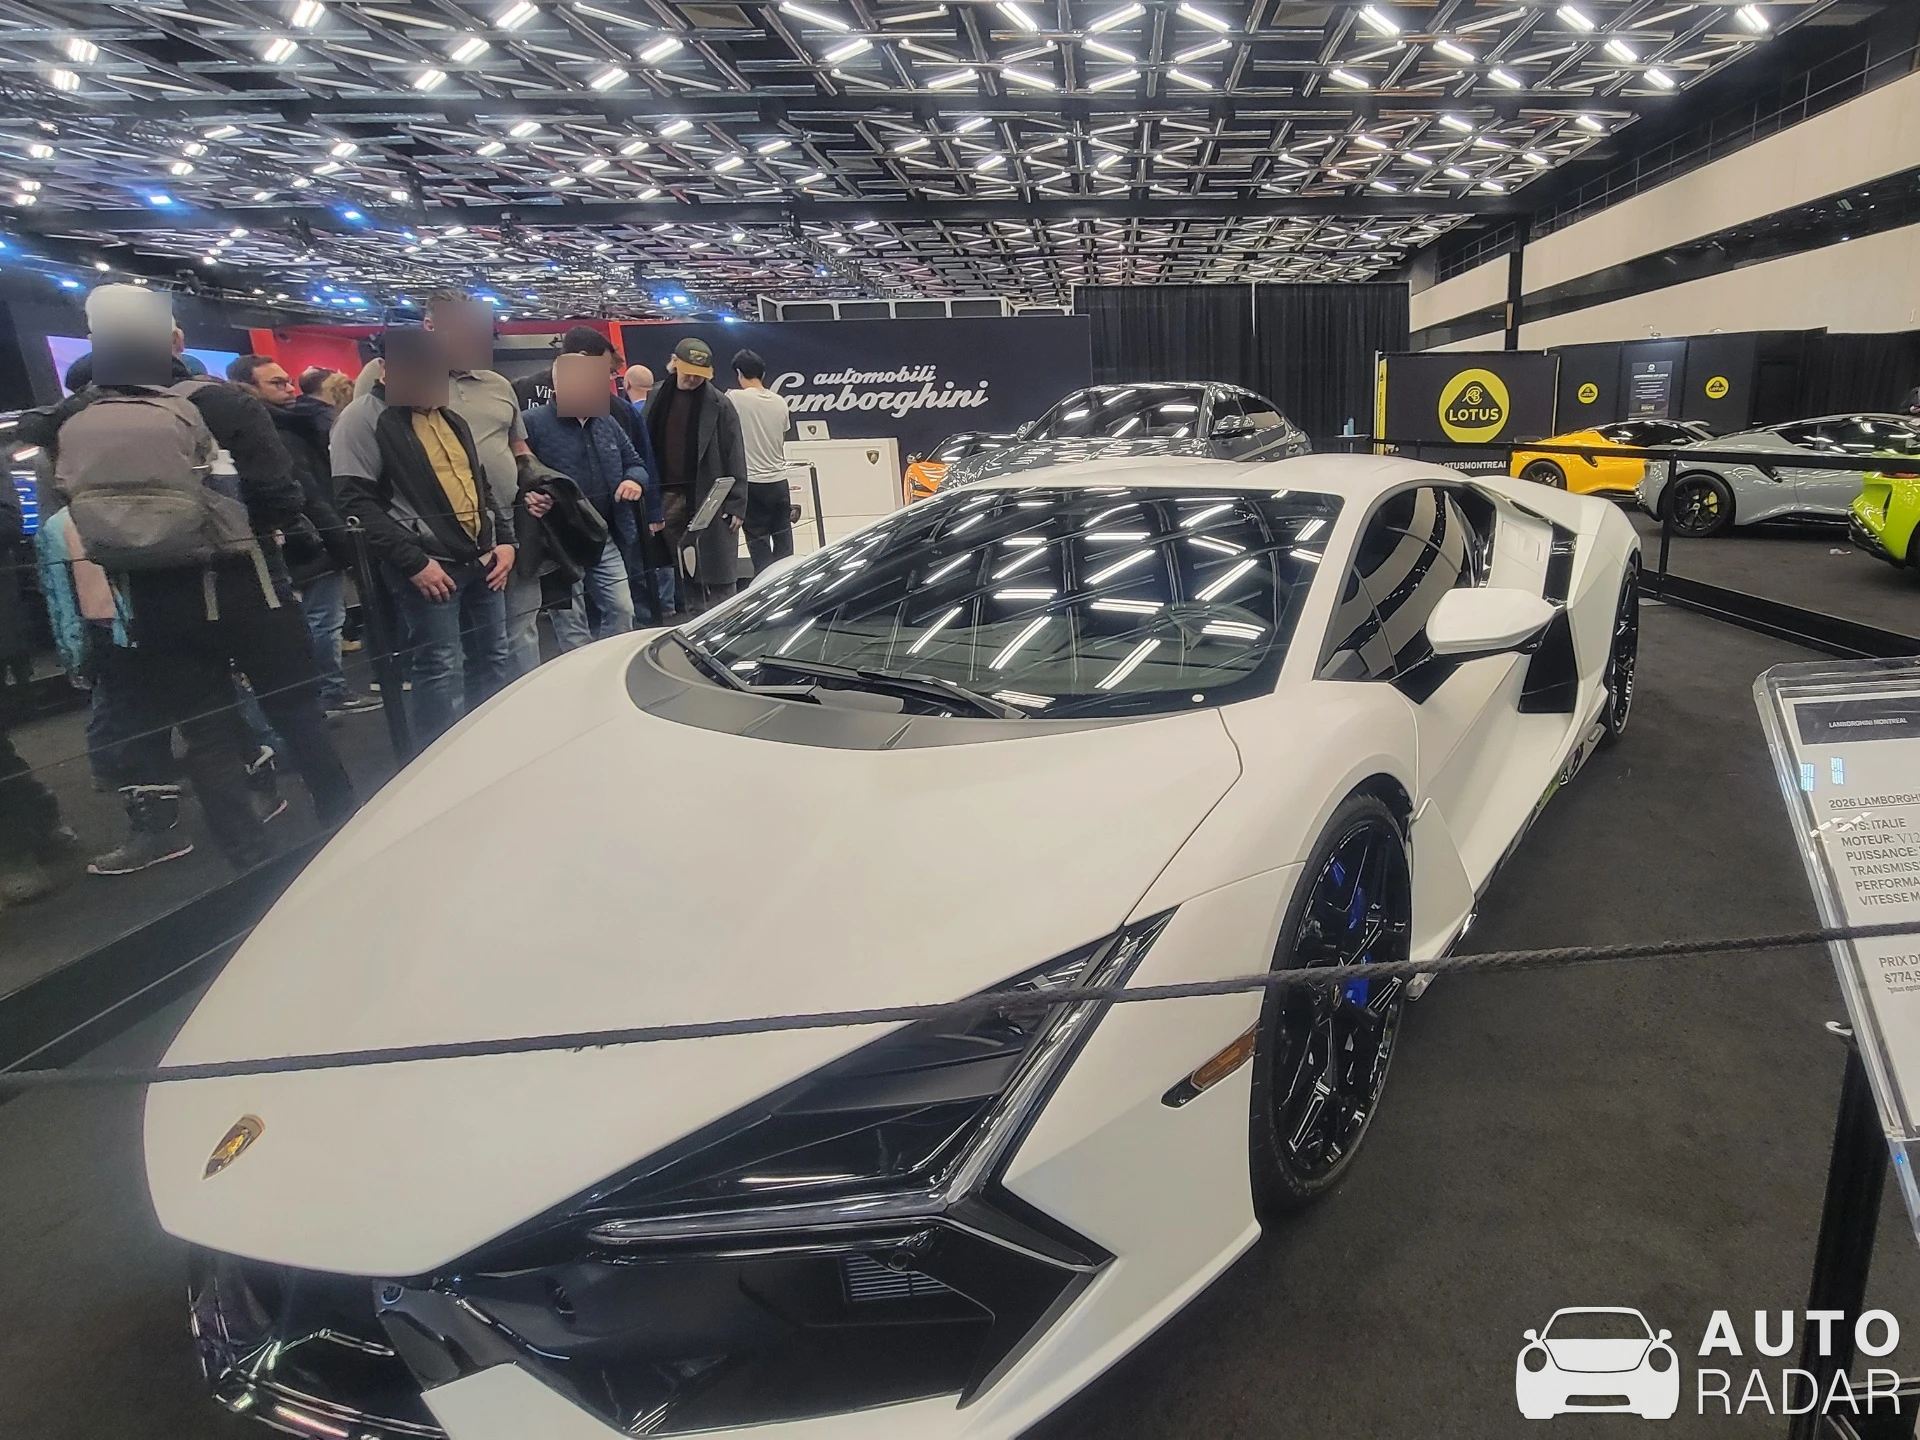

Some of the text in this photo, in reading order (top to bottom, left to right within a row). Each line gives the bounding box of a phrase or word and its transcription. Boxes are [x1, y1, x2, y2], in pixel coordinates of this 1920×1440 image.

[813, 365, 938, 386] automobili
[769, 372, 989, 418] Lamborghini
[1449, 408, 1499, 421] LOTUS
[1829, 798, 1856, 808] 2026
[1837, 817, 1907, 832] PYS: ITALIE
[1841, 832, 1920, 847] MOTEUR: V12
[1846, 846, 1918, 861] PUISSANCE:
[1855, 877, 1920, 891] PERFORMA
[1859, 891, 1909, 906] VITESSE
[1879, 955, 1908, 968] PRIX
